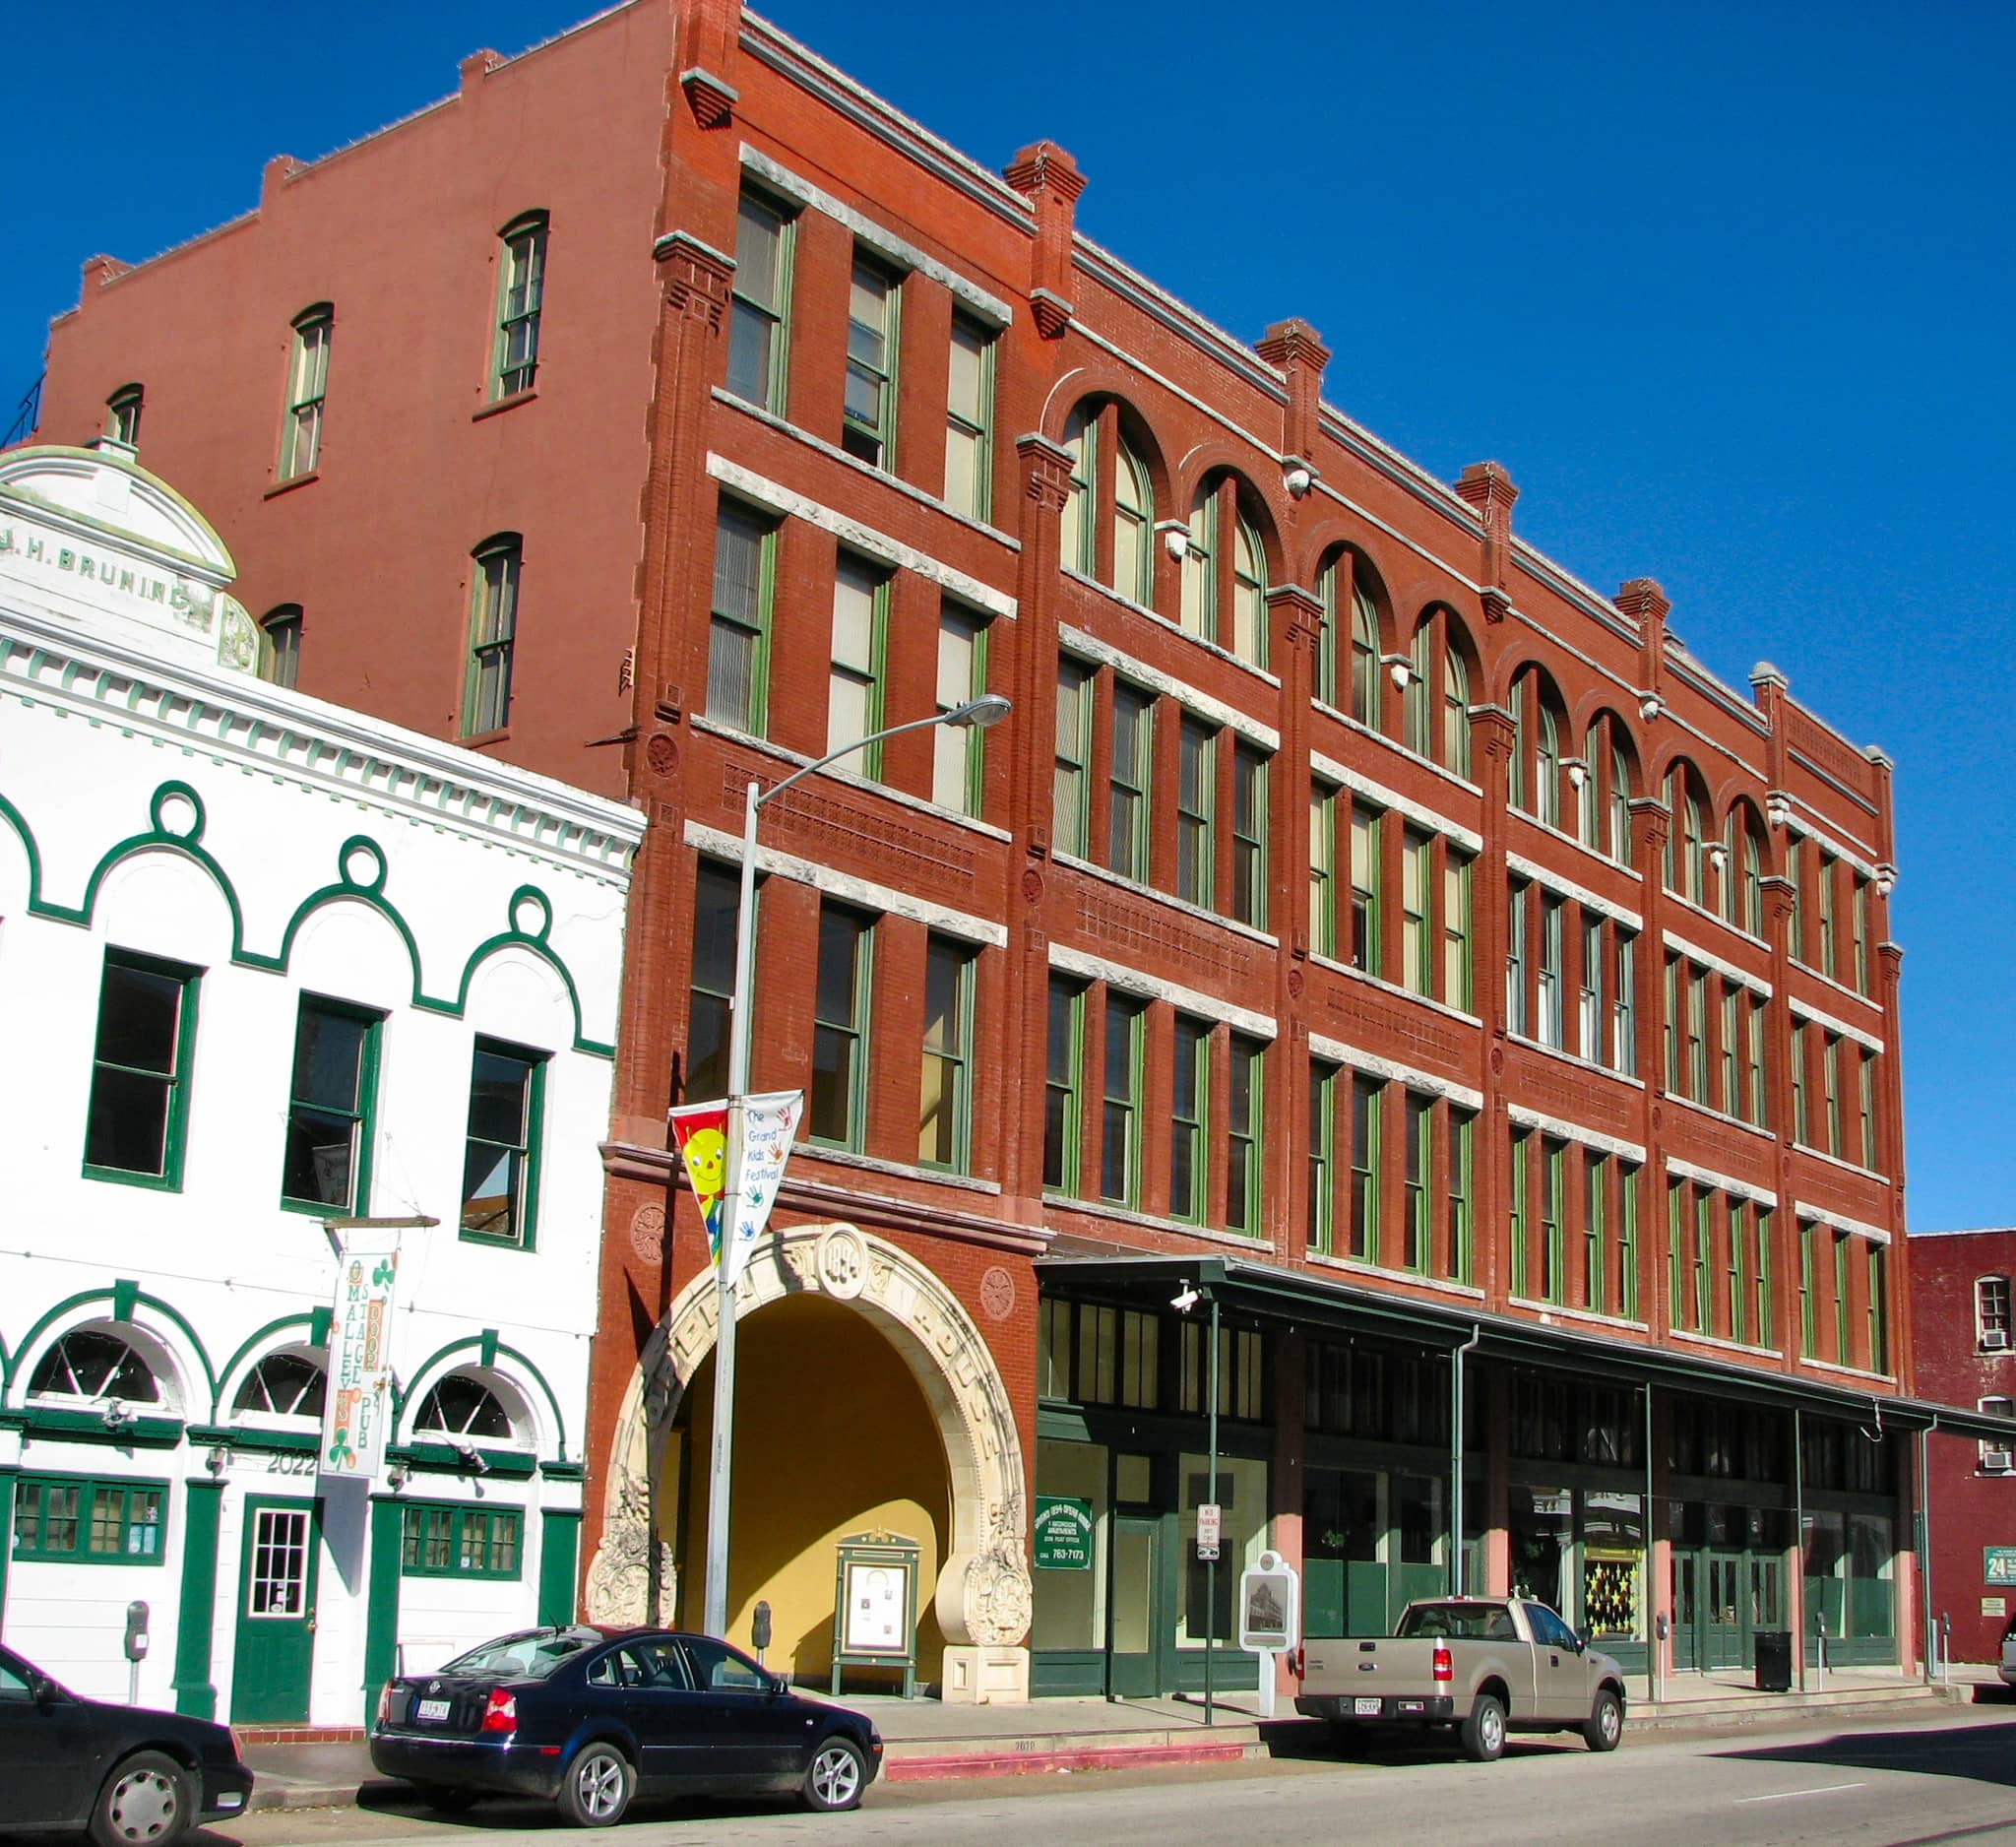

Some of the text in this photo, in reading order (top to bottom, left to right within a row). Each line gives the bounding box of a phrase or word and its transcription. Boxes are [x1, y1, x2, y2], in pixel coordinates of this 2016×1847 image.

[747, 1110, 765, 1125] The
[748, 1131, 778, 1143] Grand
[747, 1149, 765, 1162] Kids
[745, 1168, 779, 1182] Festival
[350, 1283, 369, 1384] STAGE
[364, 1306, 380, 1371] DOOR
[357, 1397, 371, 1449] PUB
[267, 1452, 316, 1476] 2022
[1052, 1549, 1084, 1560] 763-7173
[1988, 1558, 2005, 1576] 24
